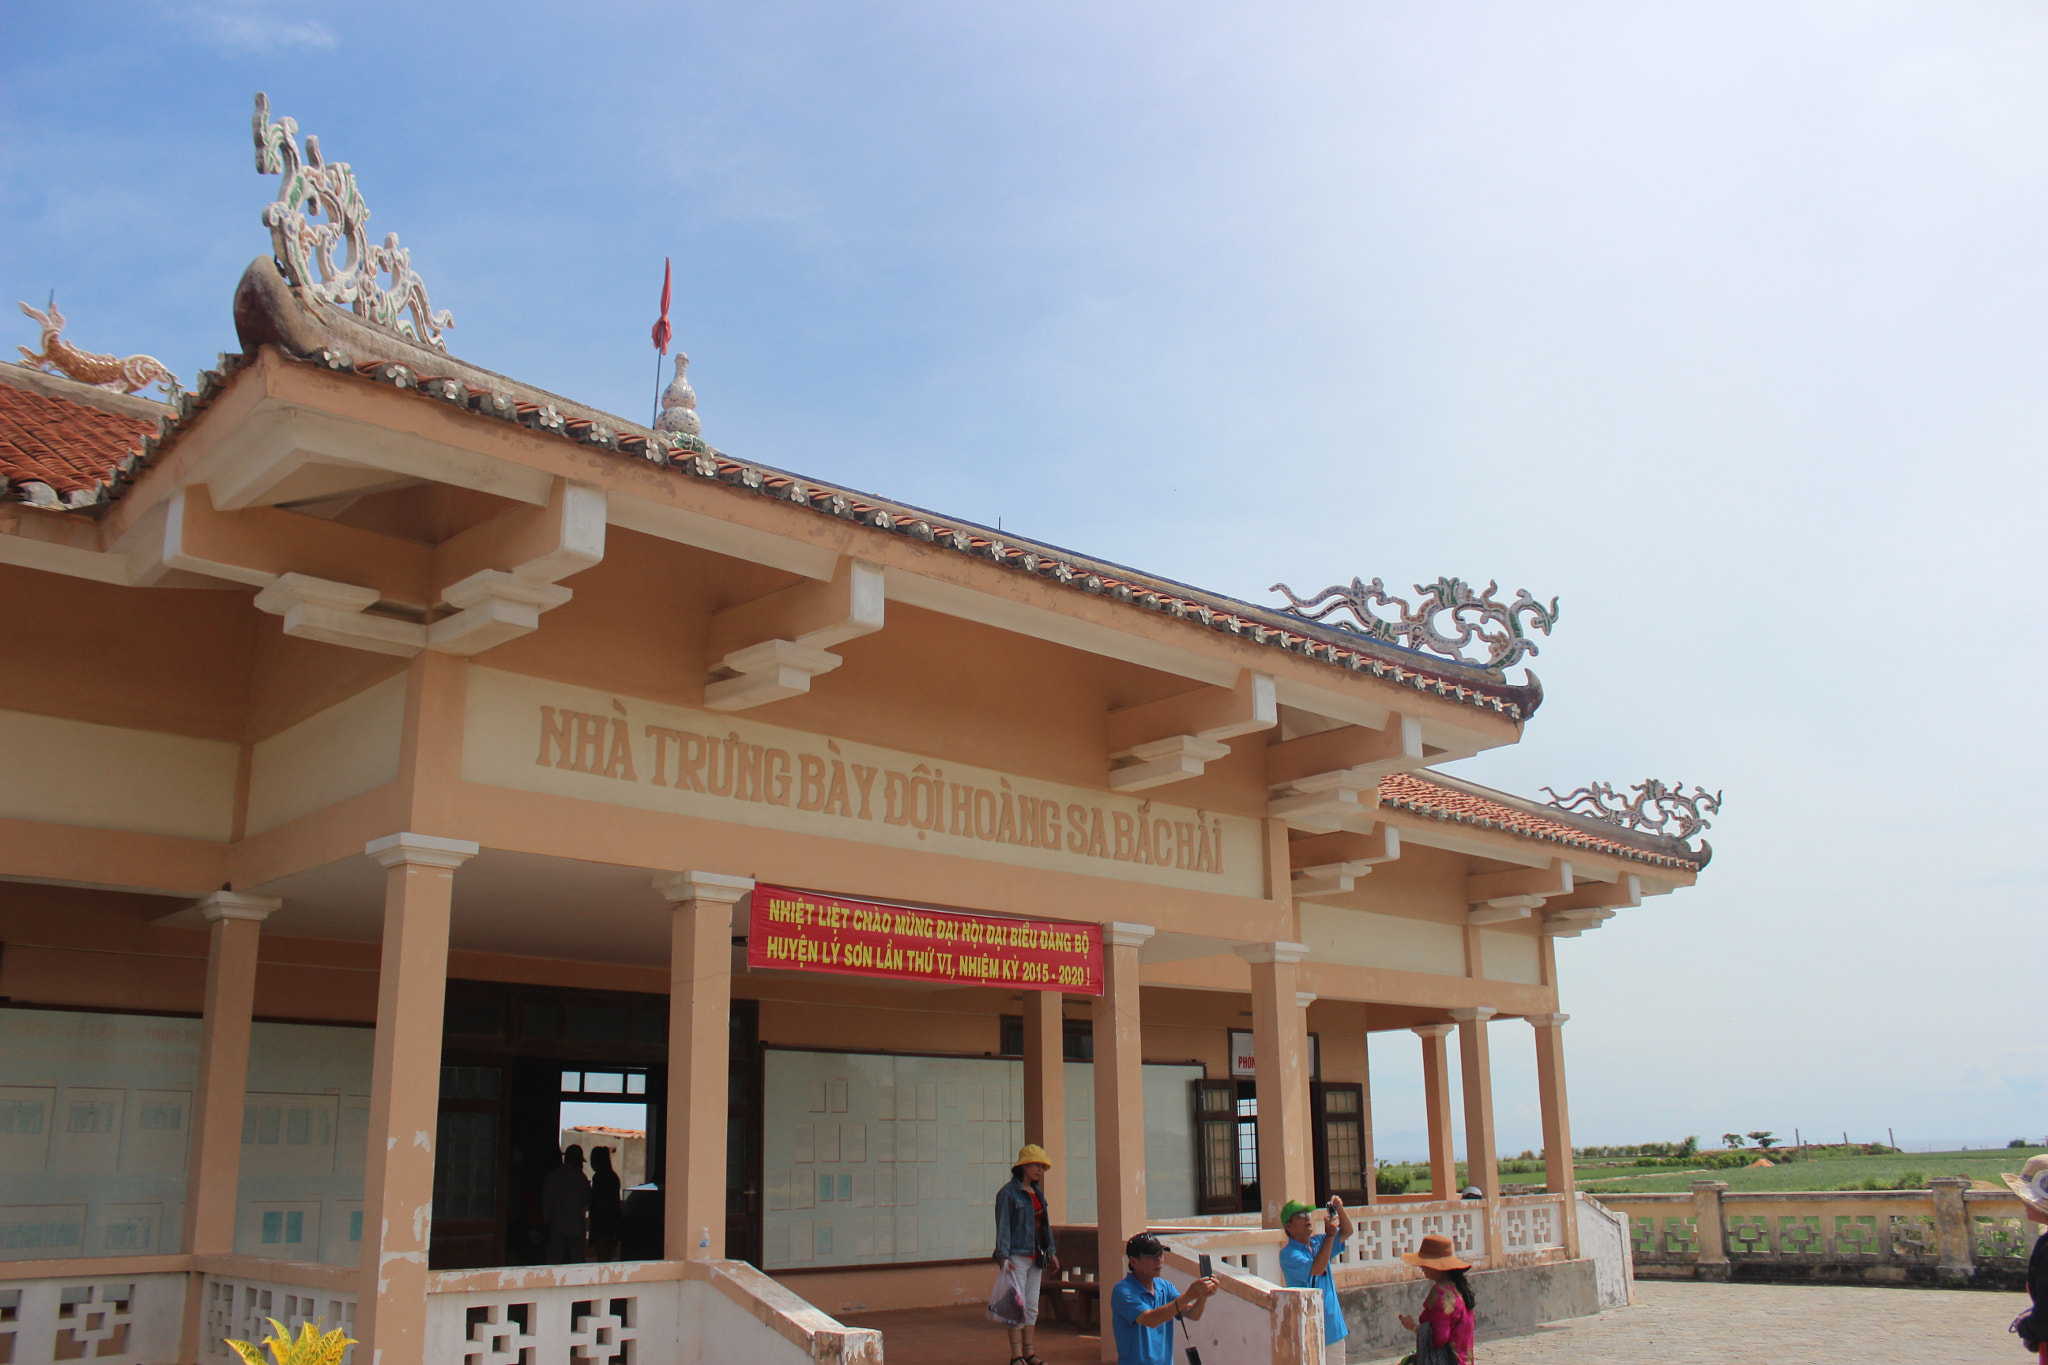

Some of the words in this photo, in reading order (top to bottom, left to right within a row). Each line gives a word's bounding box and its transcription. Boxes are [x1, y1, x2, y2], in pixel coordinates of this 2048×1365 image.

[536, 698, 637, 782] NHÀ
[646, 725, 792, 807] TRƯNG
[797, 739, 879, 818] BÀY
[884, 763, 945, 840] ĐỘI
[949, 776, 1062, 850] HOÀNG
[1067, 804, 1111, 859] SA
[1112, 799, 1173, 866] BẮC
[767, 934, 818, 968] HUYỆN
[822, 937, 840, 964] LÝ
[844, 941, 873, 967] SƠN
[876, 939, 903, 970] LẦN
[907, 946, 934, 974] THỨ
[937, 952, 956, 980] VI,
[959, 953, 999, 984] NHIỆM
[1002, 955, 1019, 980] KỲ
[769, 898, 814, 930] NHIỆT
[818, 902, 850, 934] LIỆT
[853, 907, 891, 933] CHÀO
[894, 911, 933, 938] MỪNG
[936, 917, 958, 946] ĐẠI
[961, 919, 983, 949] HỘI
[986, 923, 1007, 951] ĐẠI
[1010, 922, 1037, 949] BIỂU
[1040, 924, 1071, 952] ĐẢNG
[1074, 931, 1089, 959] BỘ
